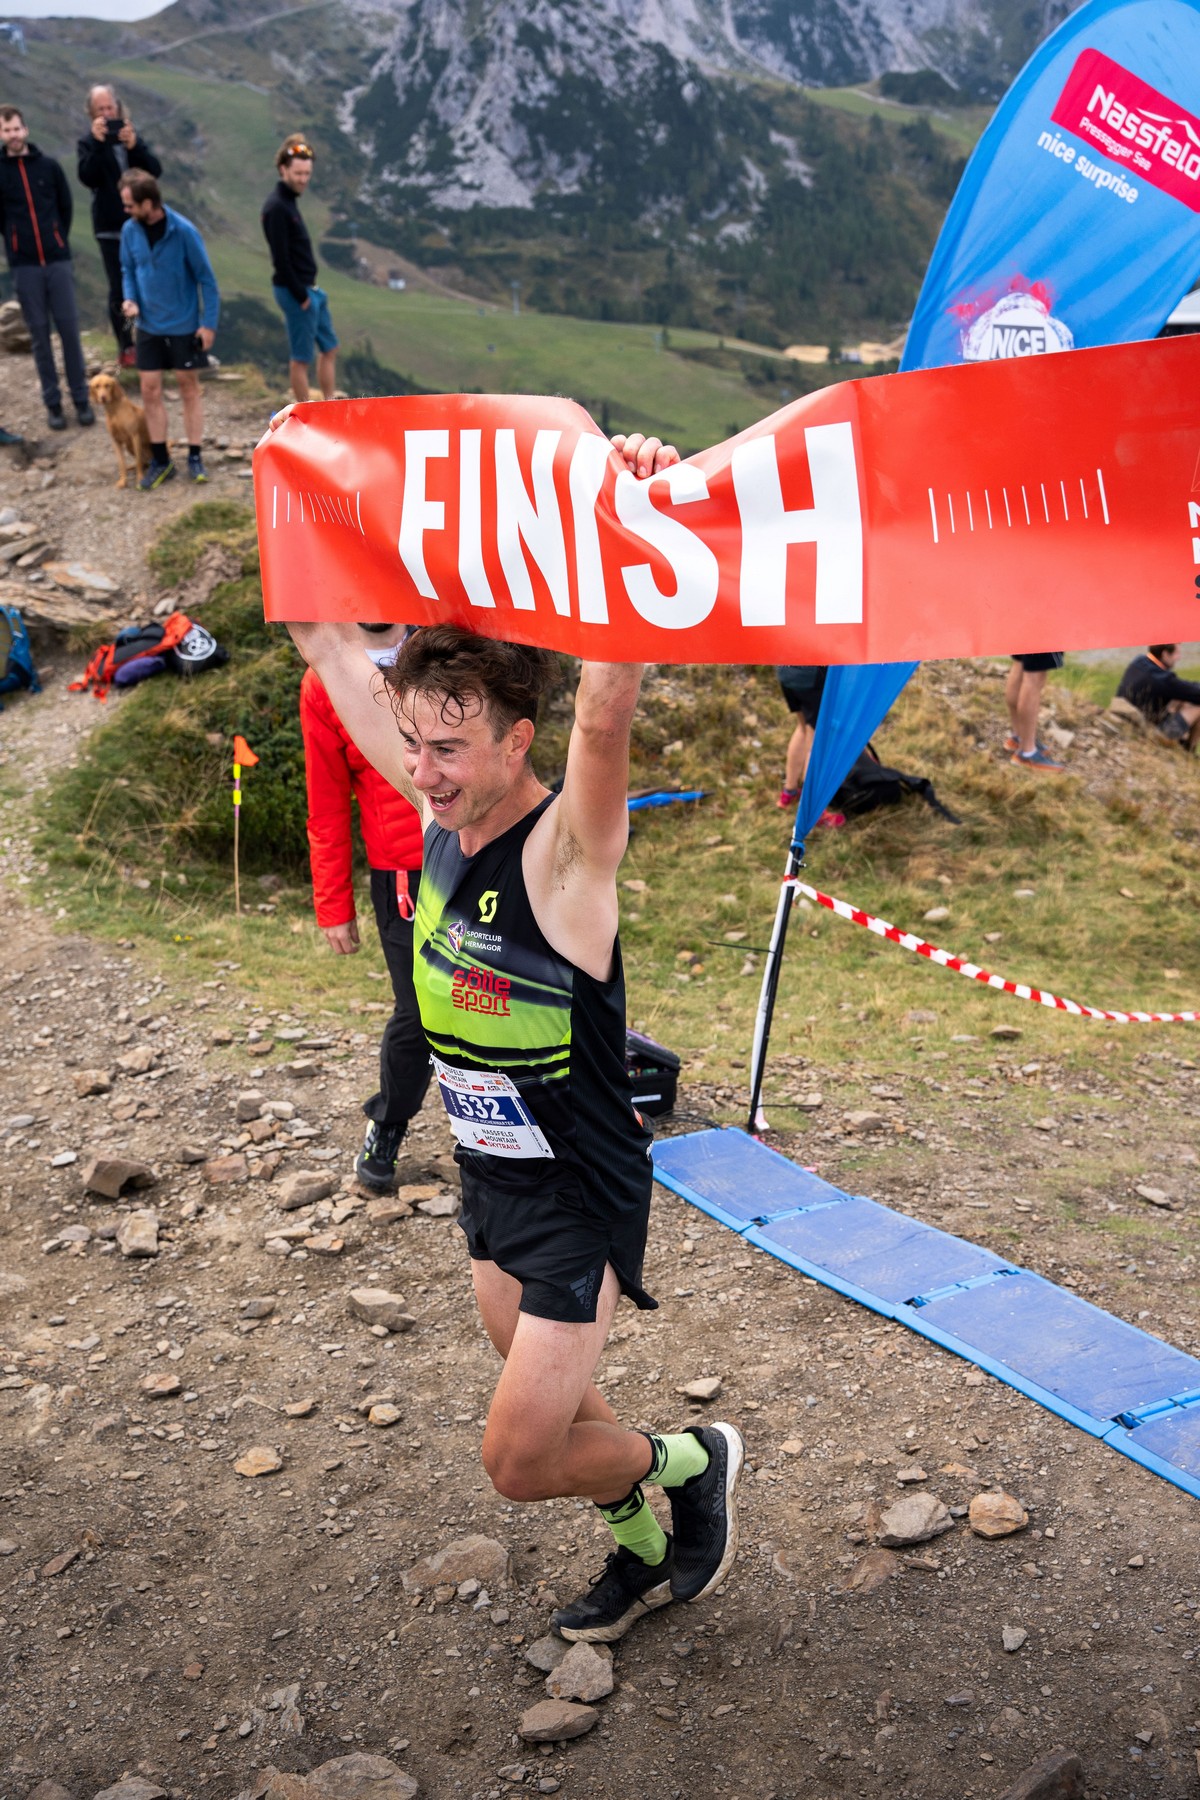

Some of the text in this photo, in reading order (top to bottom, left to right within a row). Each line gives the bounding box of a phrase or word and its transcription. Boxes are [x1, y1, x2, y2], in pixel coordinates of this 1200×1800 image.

[1036, 131, 1139, 204] nice surprise
[1132, 151, 1152, 172] See
[990, 327, 1046, 360] NICE
[398, 421, 864, 631] FINISH
[464, 940, 502, 952] HERMAGOR
[466, 930, 502, 942] SPORTCLUB
[452, 966, 511, 995] sölle
[451, 988, 511, 1012] sport
[456, 1093, 507, 1120] 532
[481, 1128, 514, 1137] NASSFELD
[485, 1135, 518, 1143] MOUNTAIN
[584, 1269, 597, 1310] adidas
